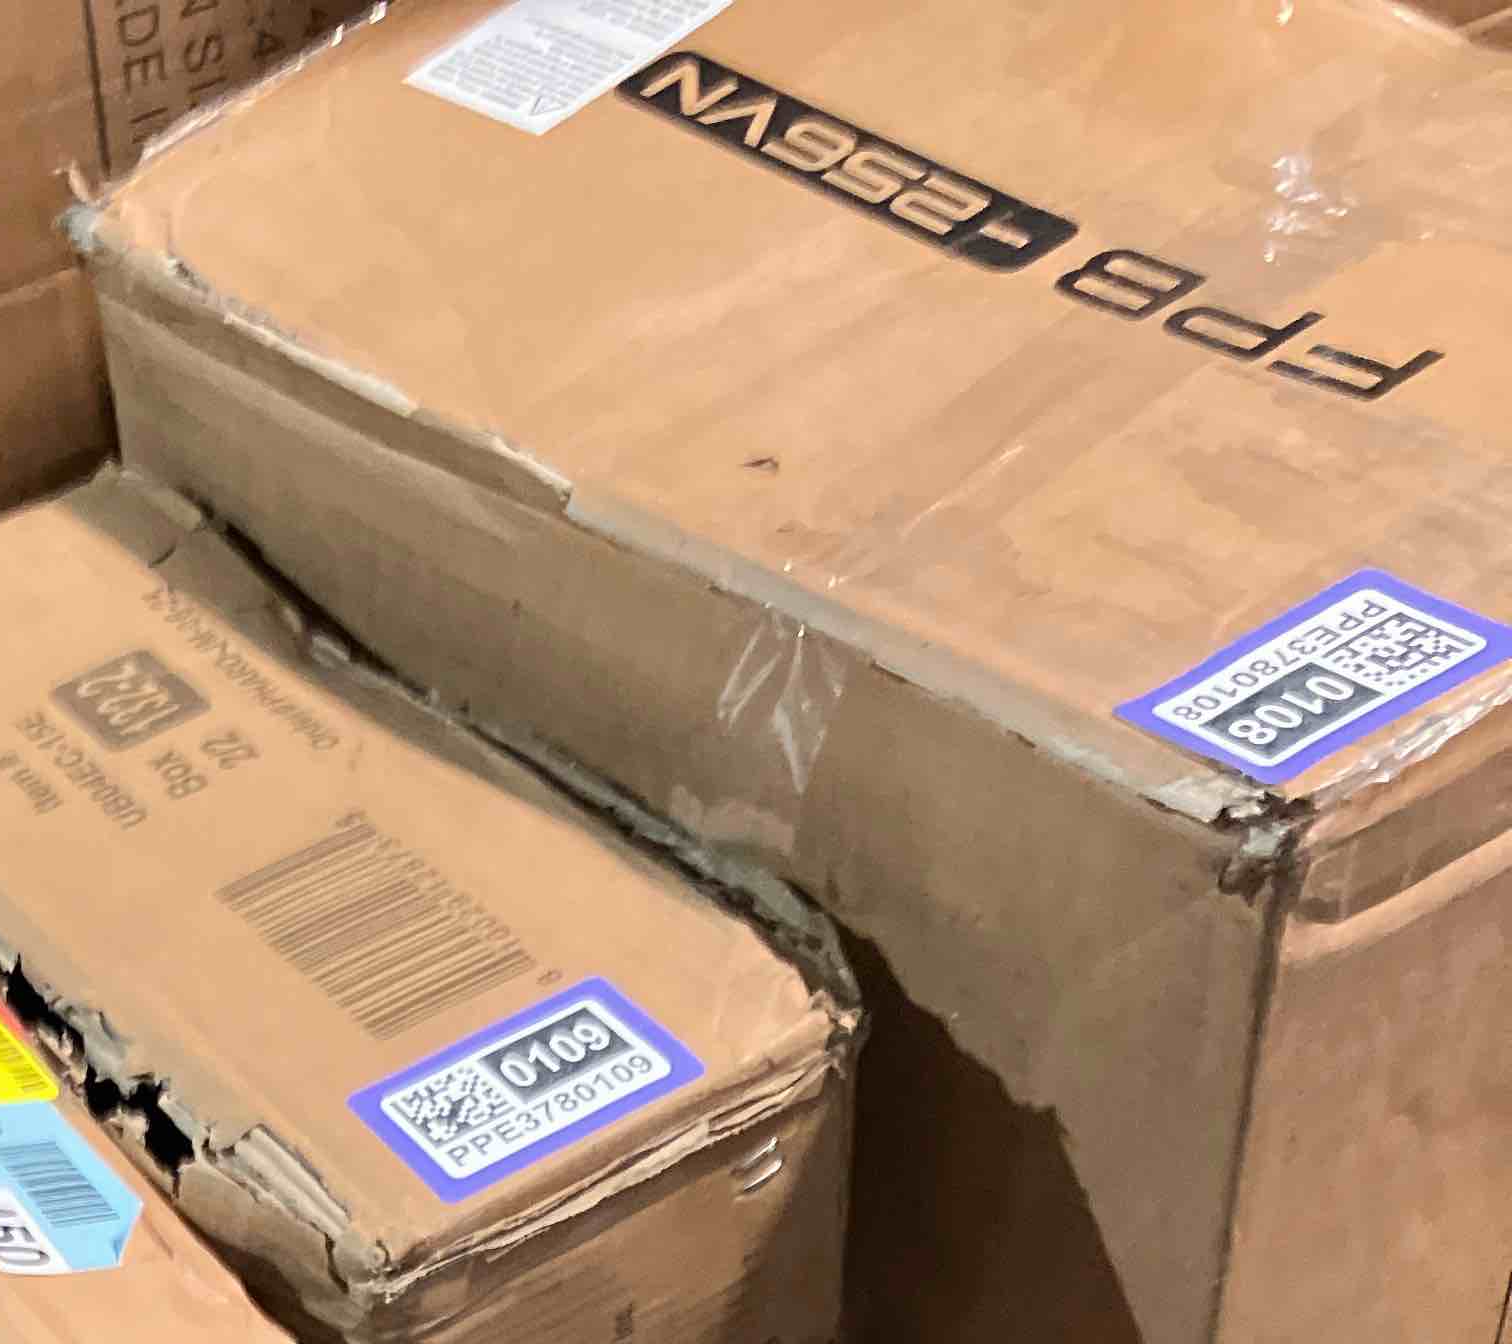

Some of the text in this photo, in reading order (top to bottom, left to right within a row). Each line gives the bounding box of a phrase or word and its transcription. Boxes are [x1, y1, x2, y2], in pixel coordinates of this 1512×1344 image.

[1174, 596, 1390, 724] PPE3780108
[1230, 668, 1353, 749] 0108
[10, 764, 65, 815] Item
[148, 748, 210, 801] Box
[499, 1017, 613, 1090] 0109
[447, 1053, 656, 1169] PPE3780109
